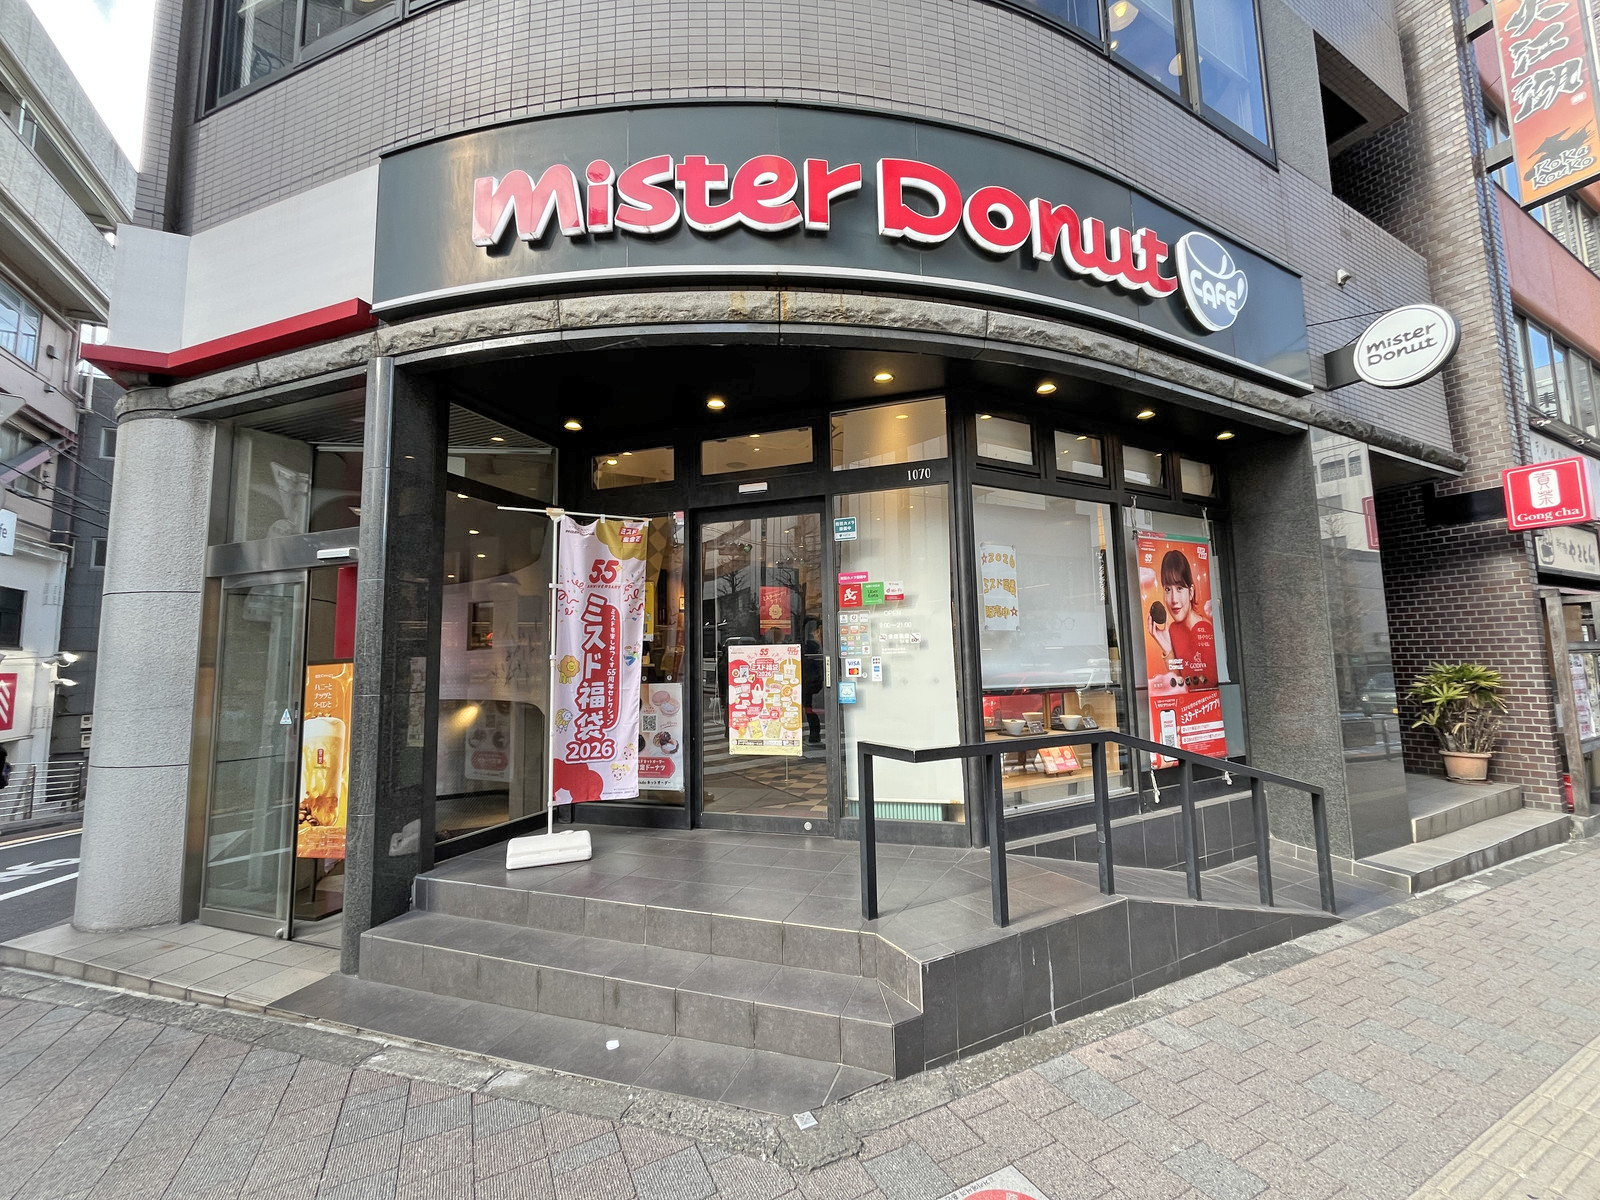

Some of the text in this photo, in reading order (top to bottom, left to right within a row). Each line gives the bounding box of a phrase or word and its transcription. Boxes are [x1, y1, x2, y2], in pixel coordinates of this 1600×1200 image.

[876, 158, 1179, 298] Donut
[1367, 337, 1438, 367] Donut
[907, 468, 931, 481] 1070
[1517, 507, 1580, 522] Gong cha
[589, 559, 620, 583] 55
[578, 594, 608, 741] ミスド福袋
[568, 742, 613, 759] 2026
